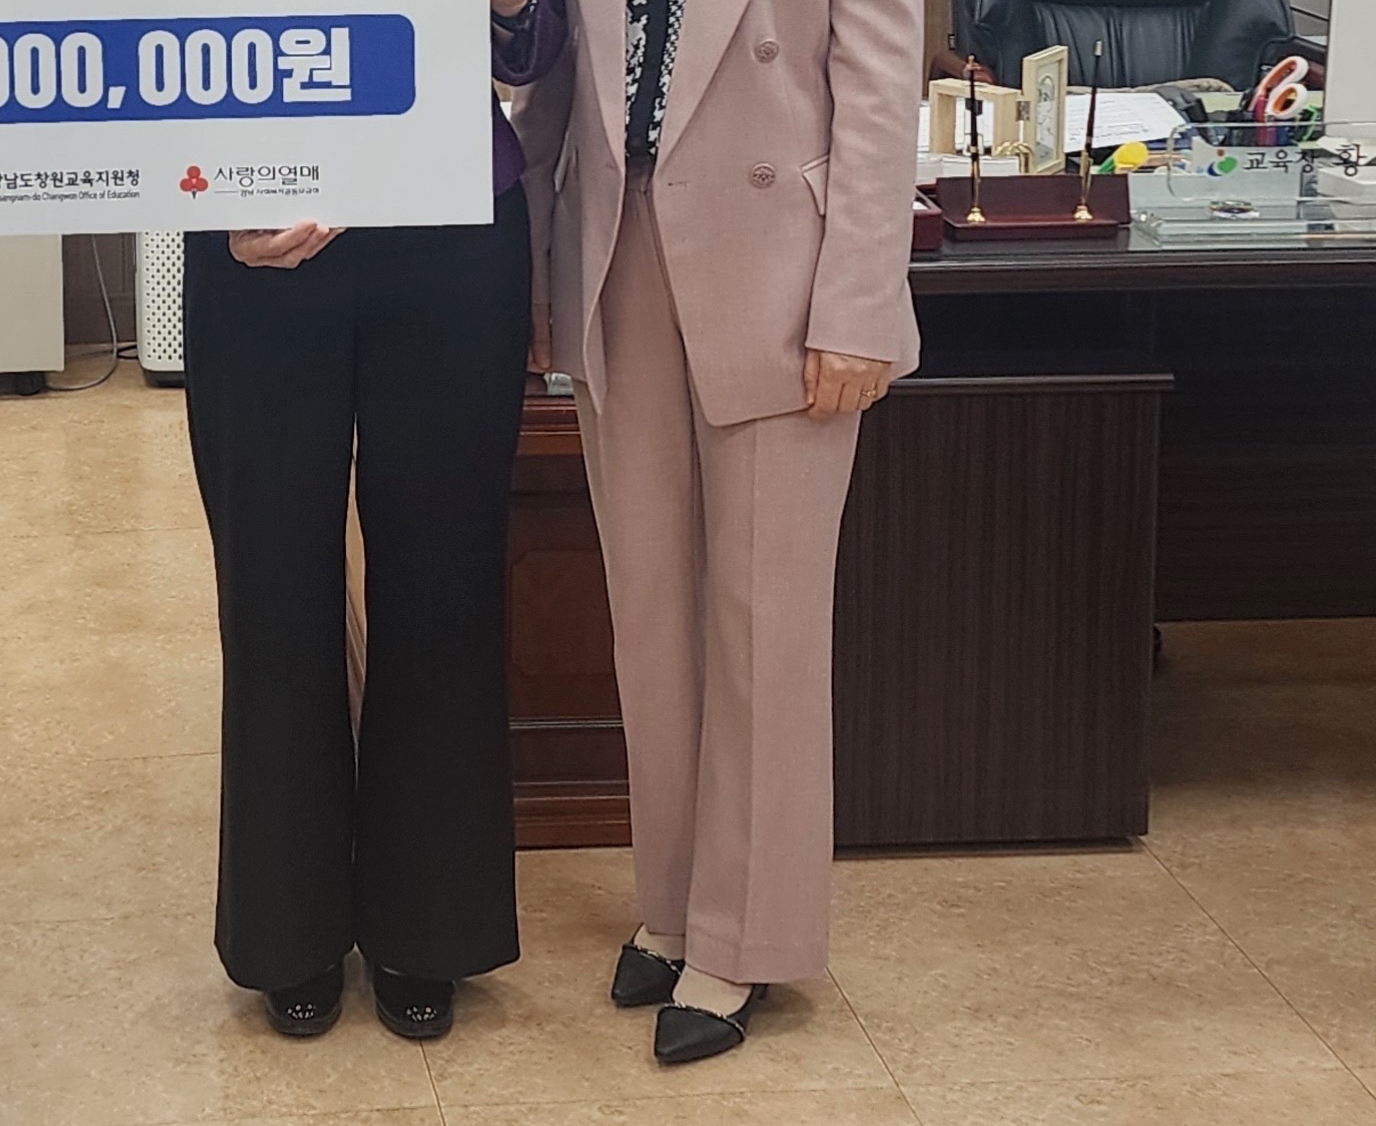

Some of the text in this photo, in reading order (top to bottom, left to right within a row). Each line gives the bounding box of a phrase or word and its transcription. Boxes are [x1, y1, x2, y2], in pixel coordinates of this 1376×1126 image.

[1244, 143, 1368, 176] 교육장 황
[214, 165, 320, 188] 사랑의열매
[107, 190, 140, 200] Education
